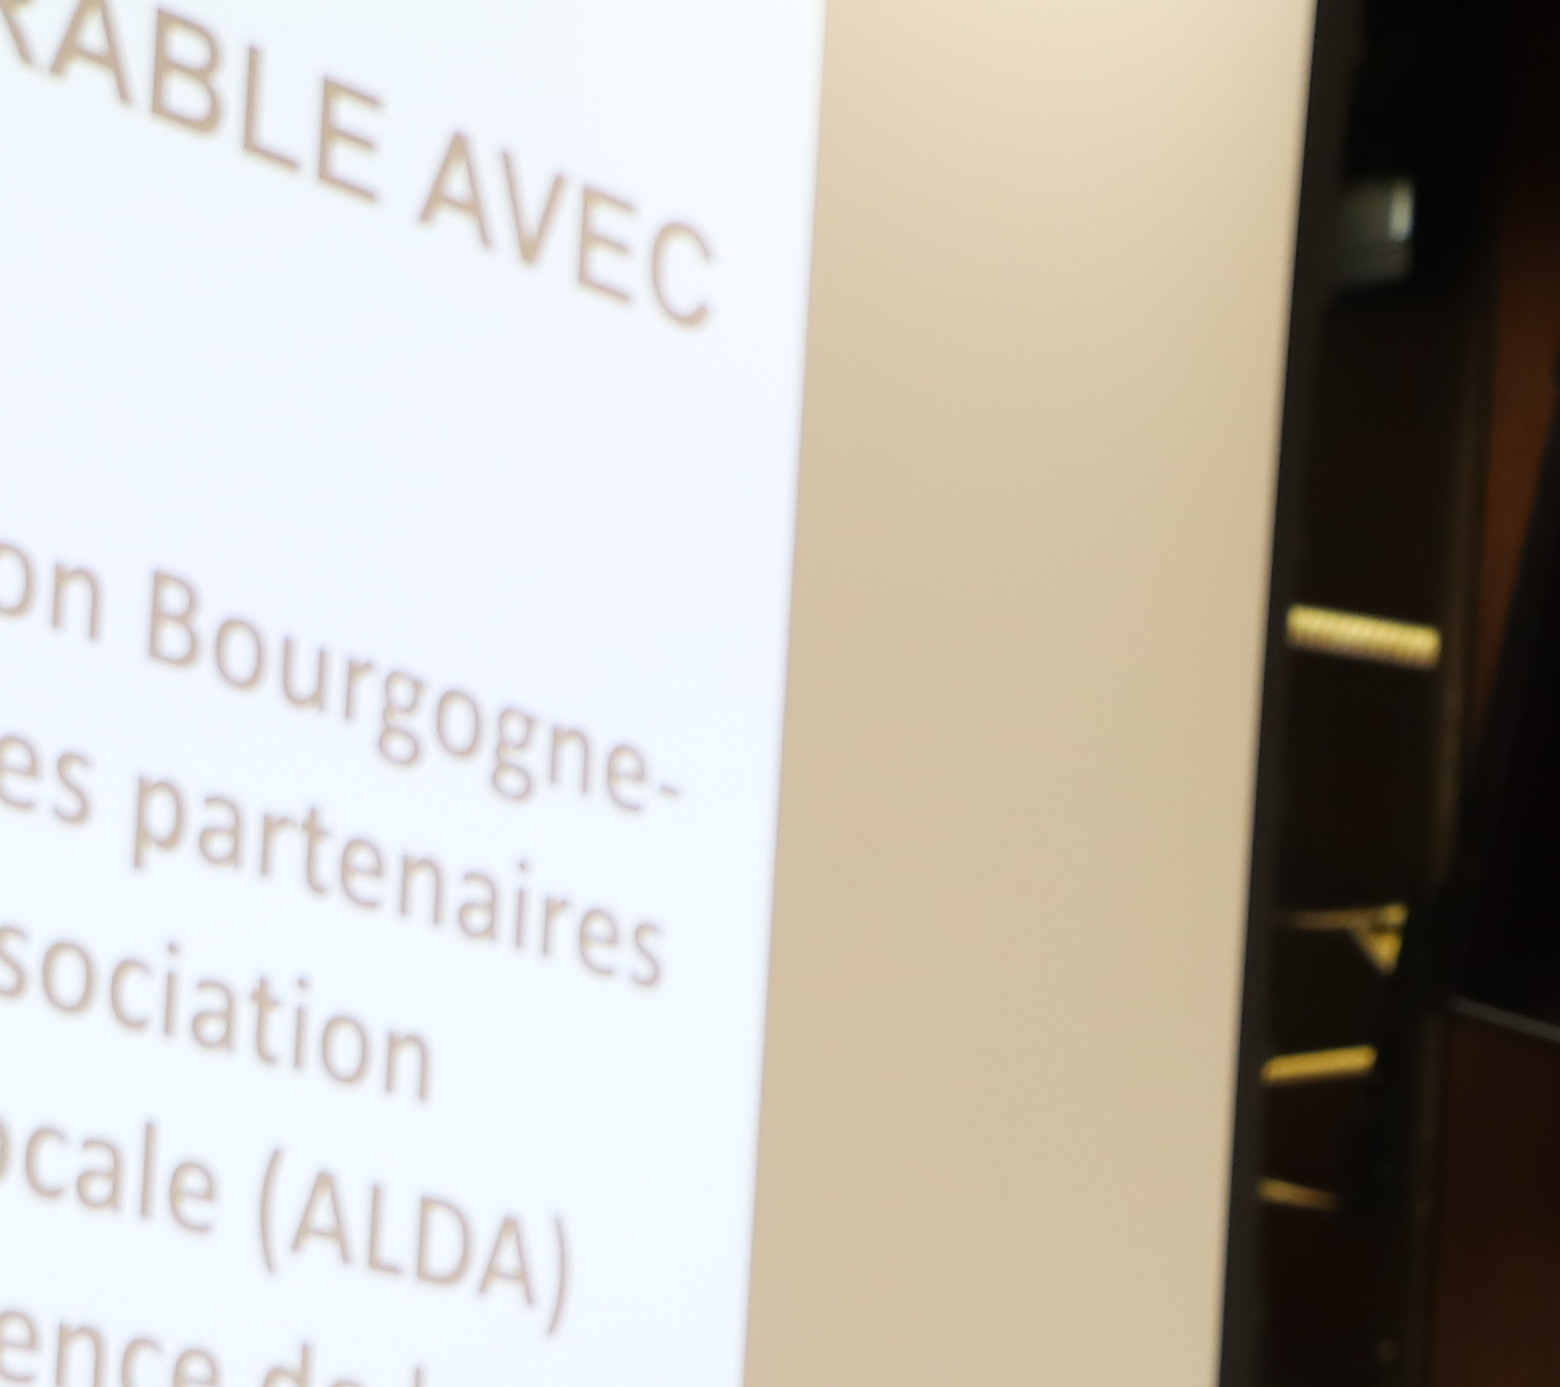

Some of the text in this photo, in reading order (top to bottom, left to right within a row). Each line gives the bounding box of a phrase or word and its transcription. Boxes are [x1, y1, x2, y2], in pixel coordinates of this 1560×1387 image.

[418, 126, 716, 332] AVEC
[147, 568, 682, 817] Bourgogne-
[132, 770, 667, 991] partenaires
[257, 1143, 572, 1339] (ALDA)
